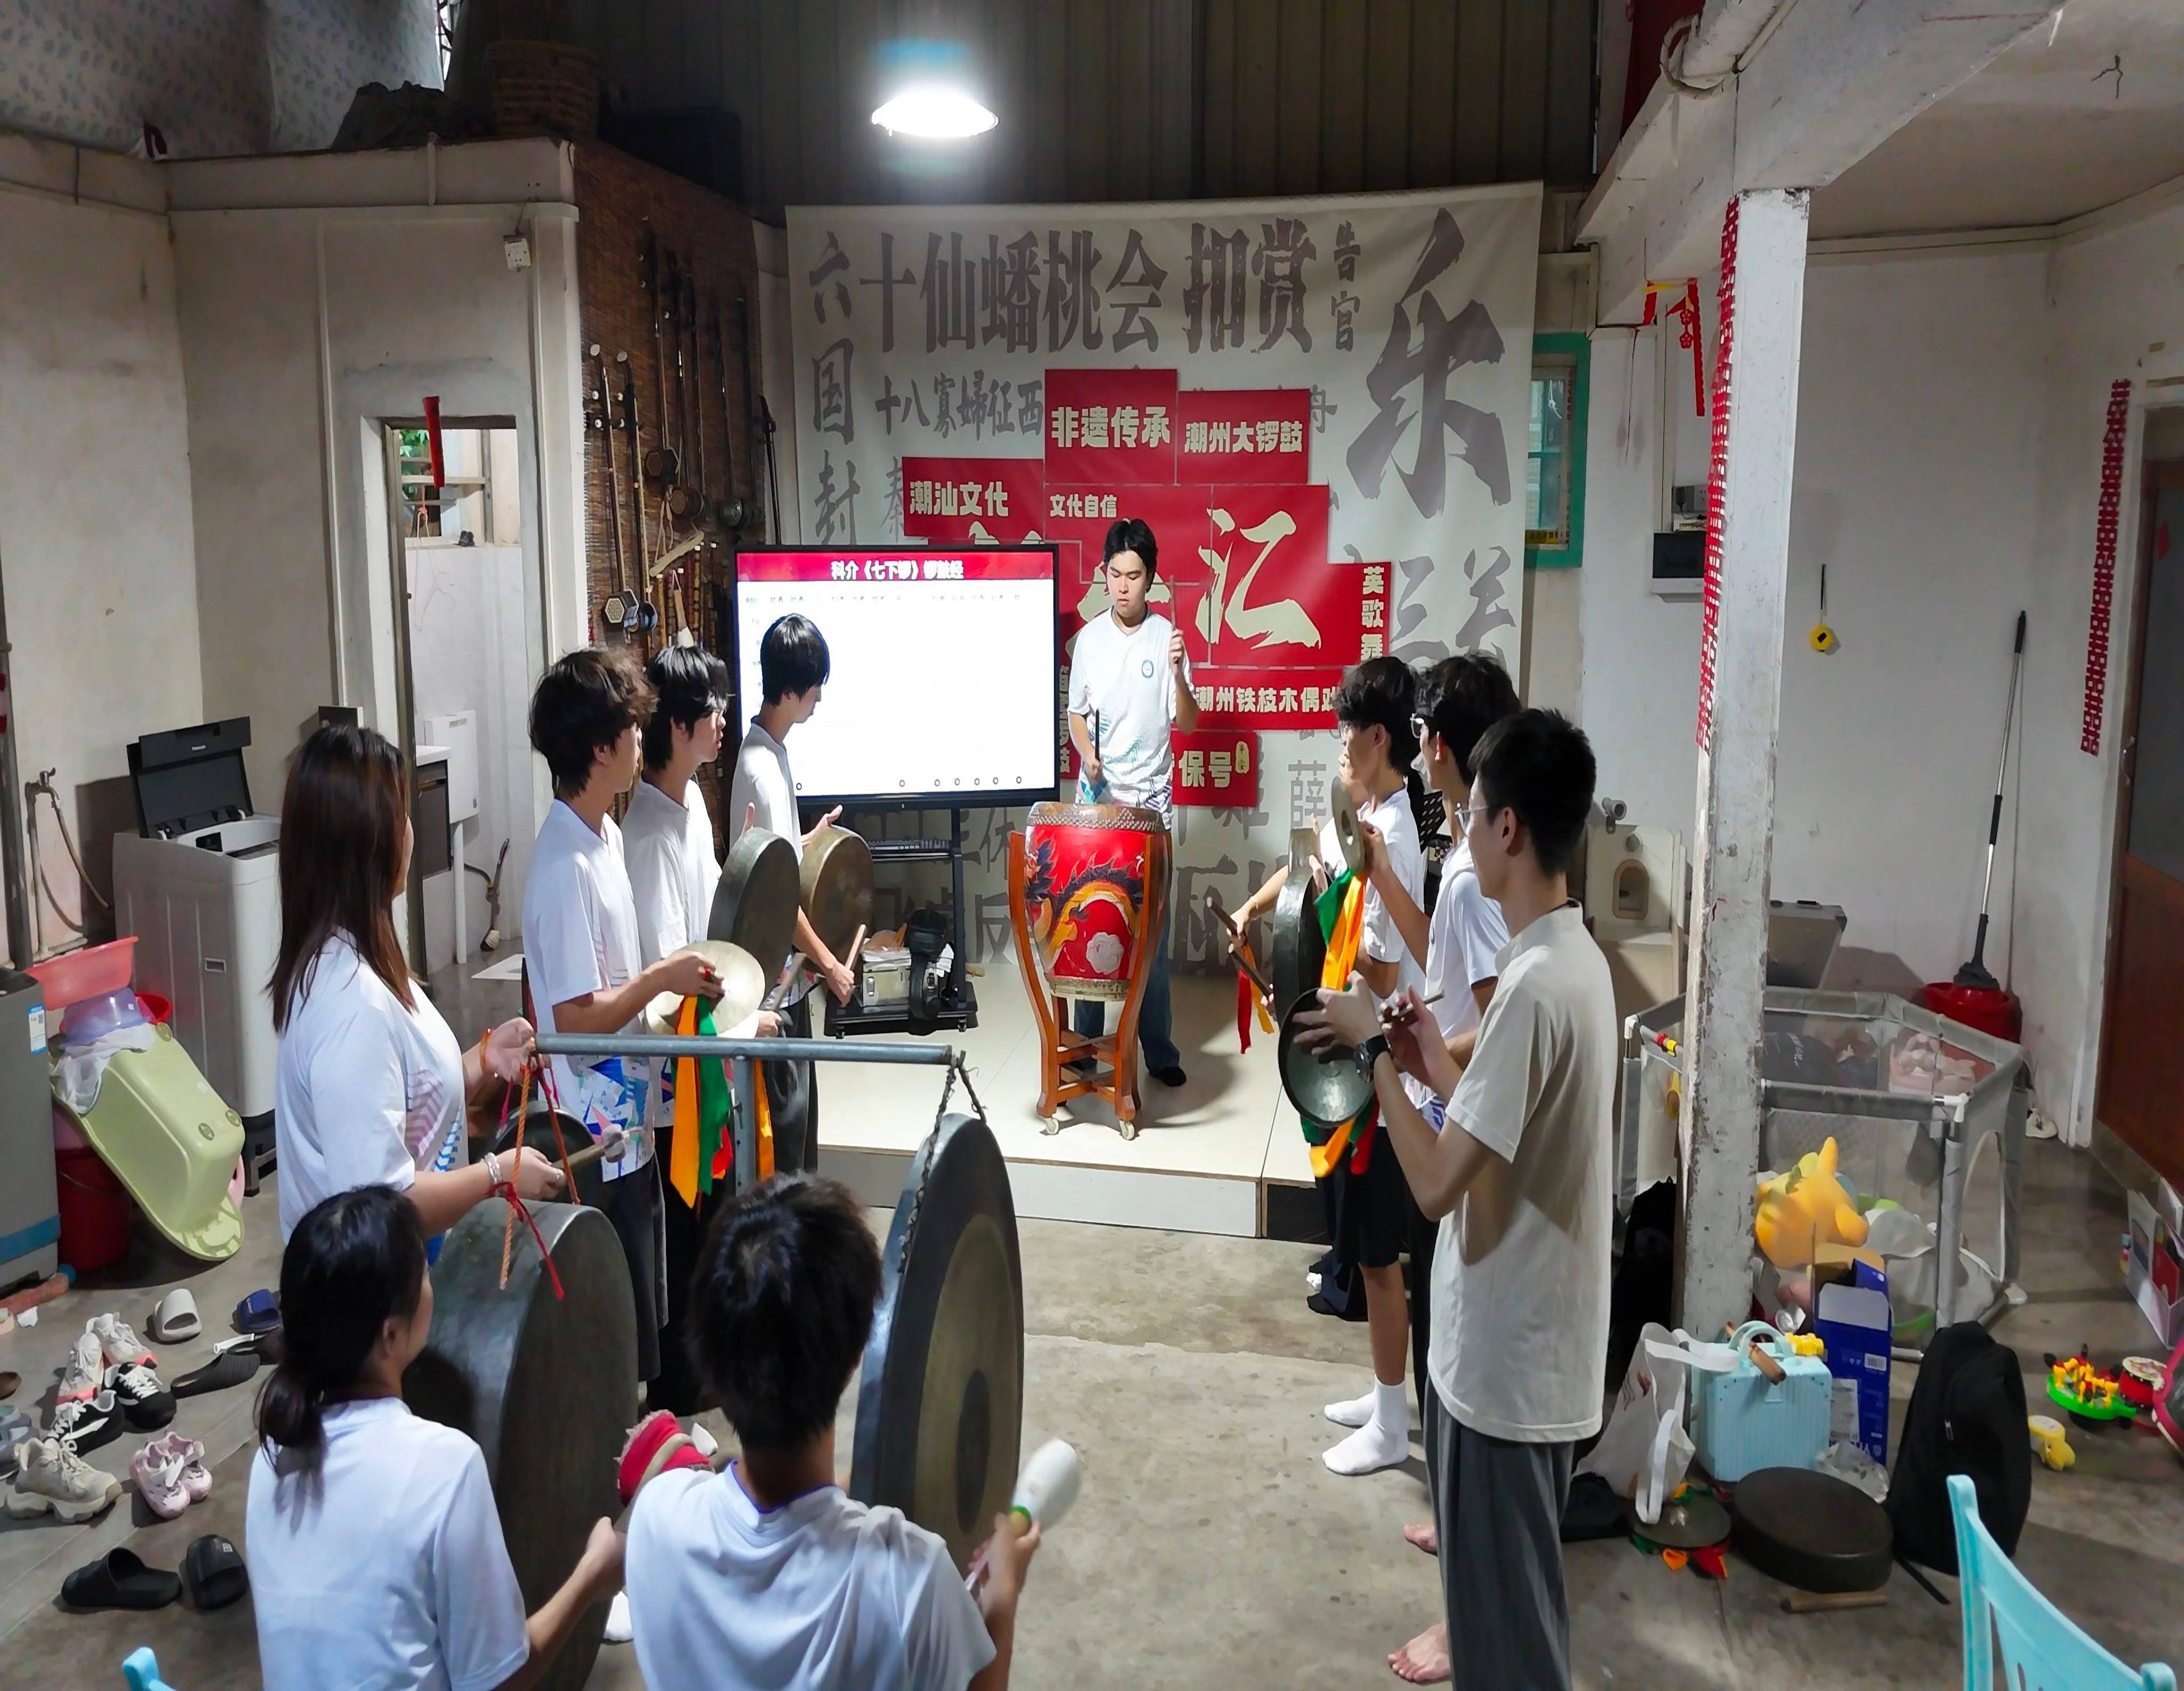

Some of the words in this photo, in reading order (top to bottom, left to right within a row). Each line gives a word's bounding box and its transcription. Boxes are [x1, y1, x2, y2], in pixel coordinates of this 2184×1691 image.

[1051, 406, 1170, 448] 非遗传承
[1185, 421, 1302, 453] 潮州大锣鼓
[910, 481, 1008, 516] 潮汕文化
[1050, 494, 1117, 518] 文化自信
[1361, 566, 1384, 661] 英歌舞
[1172, 751, 1232, 788] 保号
